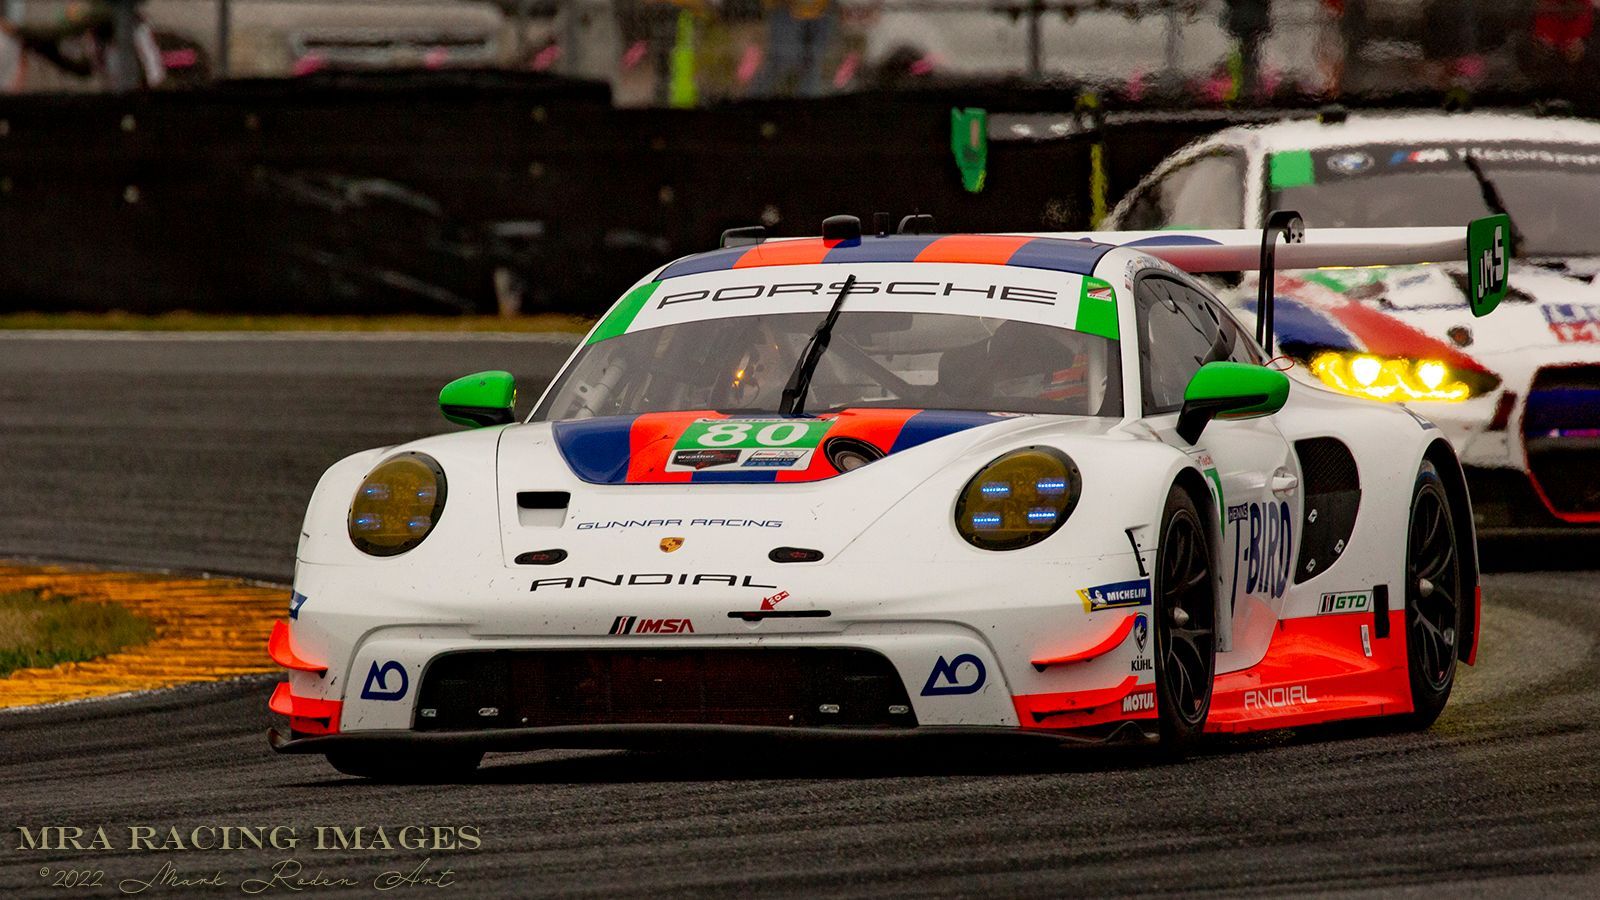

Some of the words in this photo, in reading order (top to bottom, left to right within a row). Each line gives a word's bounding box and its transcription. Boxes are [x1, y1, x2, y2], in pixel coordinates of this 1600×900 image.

[656, 281, 1058, 310] PORSCHE
[697, 422, 810, 447] 80
[576, 518, 684, 531] GUNNAR
[690, 518, 783, 529] RACING
[1228, 501, 1292, 618] T-BIRD
[530, 573, 778, 592] ANDIAL
[767, 591, 789, 606] TOW
[1106, 587, 1147, 602] MICHELIN
[1334, 594, 1367, 610] GTD
[635, 618, 695, 634] IMSA
[1131, 654, 1153, 672] KÜHL
[1123, 692, 1155, 713] MOTUL
[1244, 685, 1318, 710] ANDIAL
